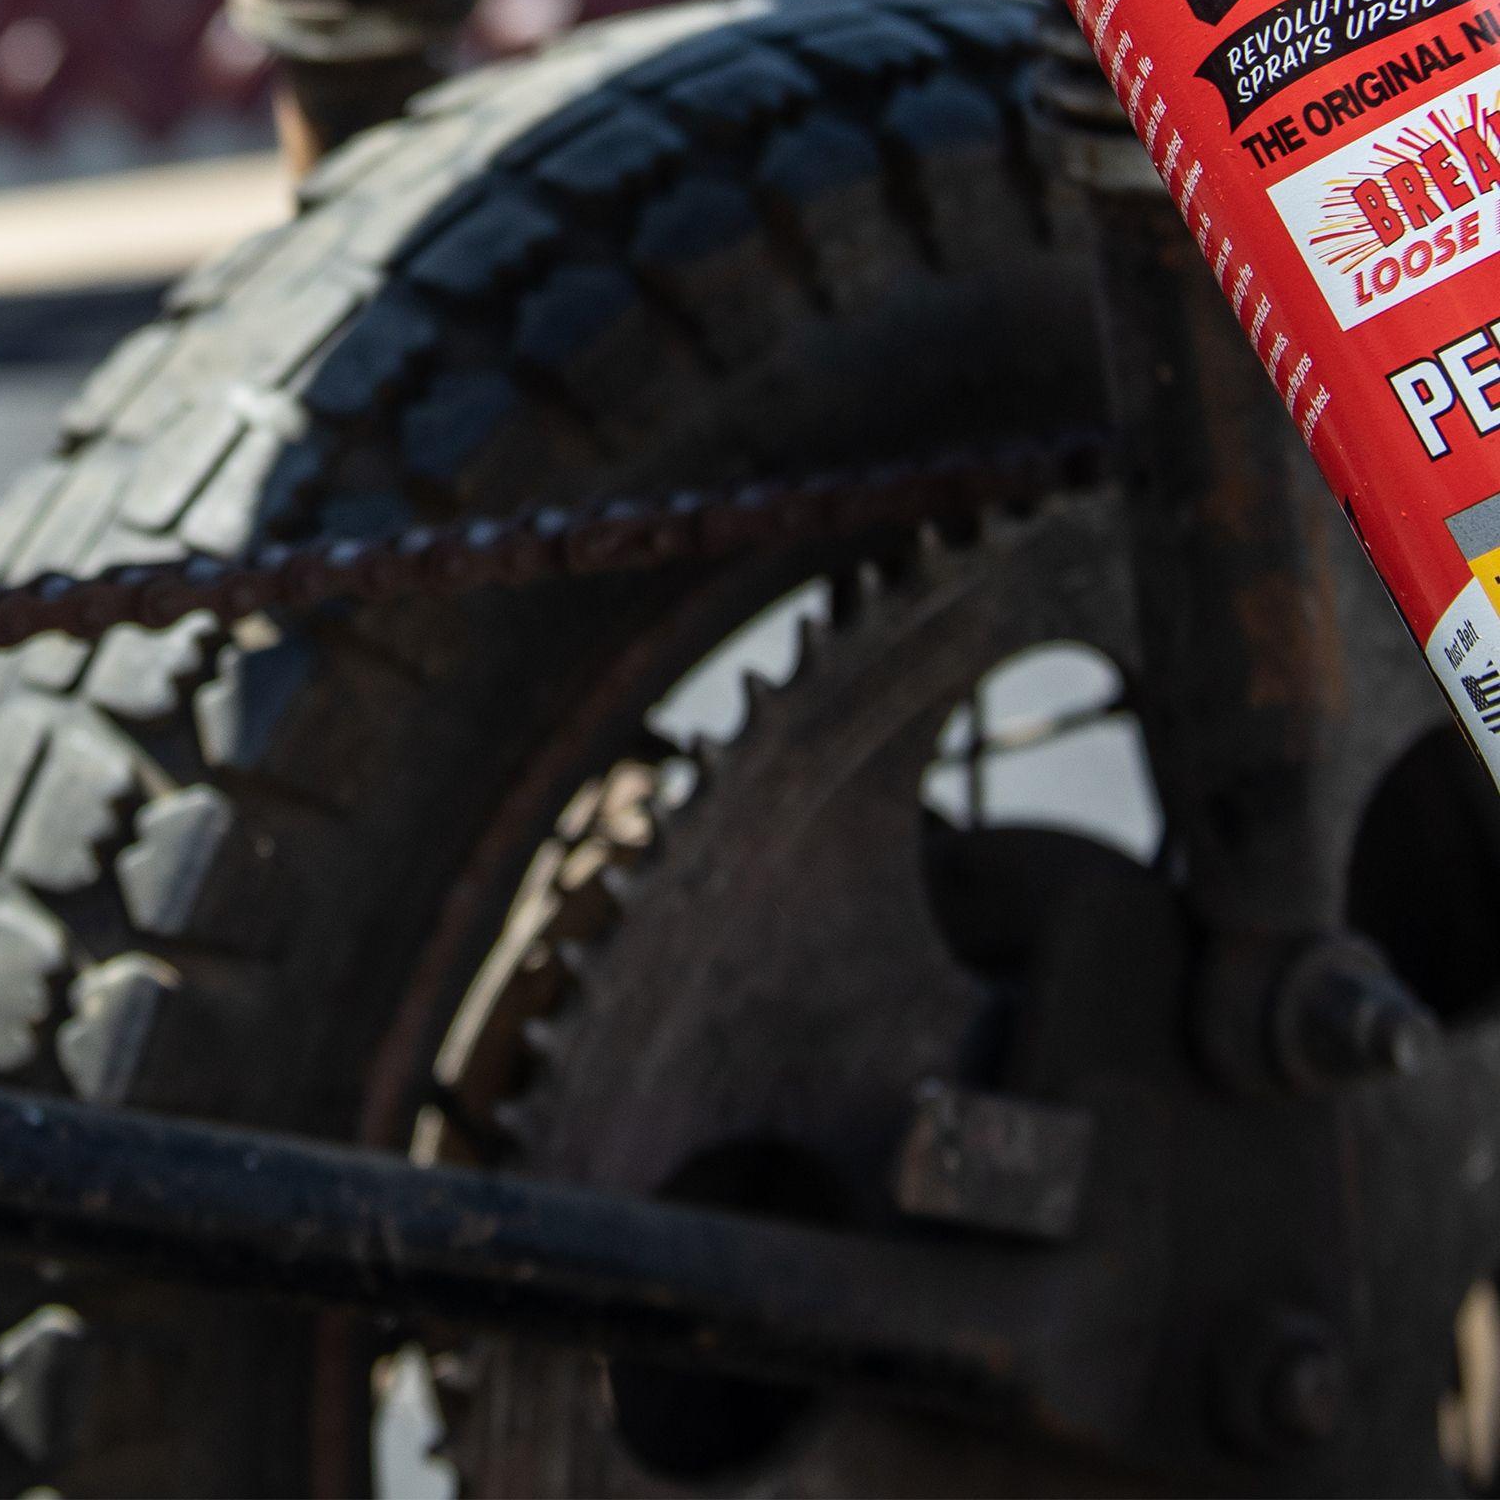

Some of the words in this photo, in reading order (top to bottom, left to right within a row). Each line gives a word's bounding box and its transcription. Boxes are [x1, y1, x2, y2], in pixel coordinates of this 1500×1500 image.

[1118, 30, 1133, 57] only
[1237, 27, 1332, 104] SPRAYS
[1137, 57, 1153, 78] We
[1151, 94, 1166, 122] that
[1241, 115, 1307, 169] THE
[1303, 35, 1466, 136] ORIGINAL
[1182, 160, 1203, 197] believe
[1352, 211, 1479, 308] LOOSE
[1253, 293, 1271, 337] product
[1296, 353, 1312, 384] pros
[1385, 317, 1500, 462] PE
[1444, 638, 1465, 671] Rust
[1456, 619, 1480, 652] Belt
